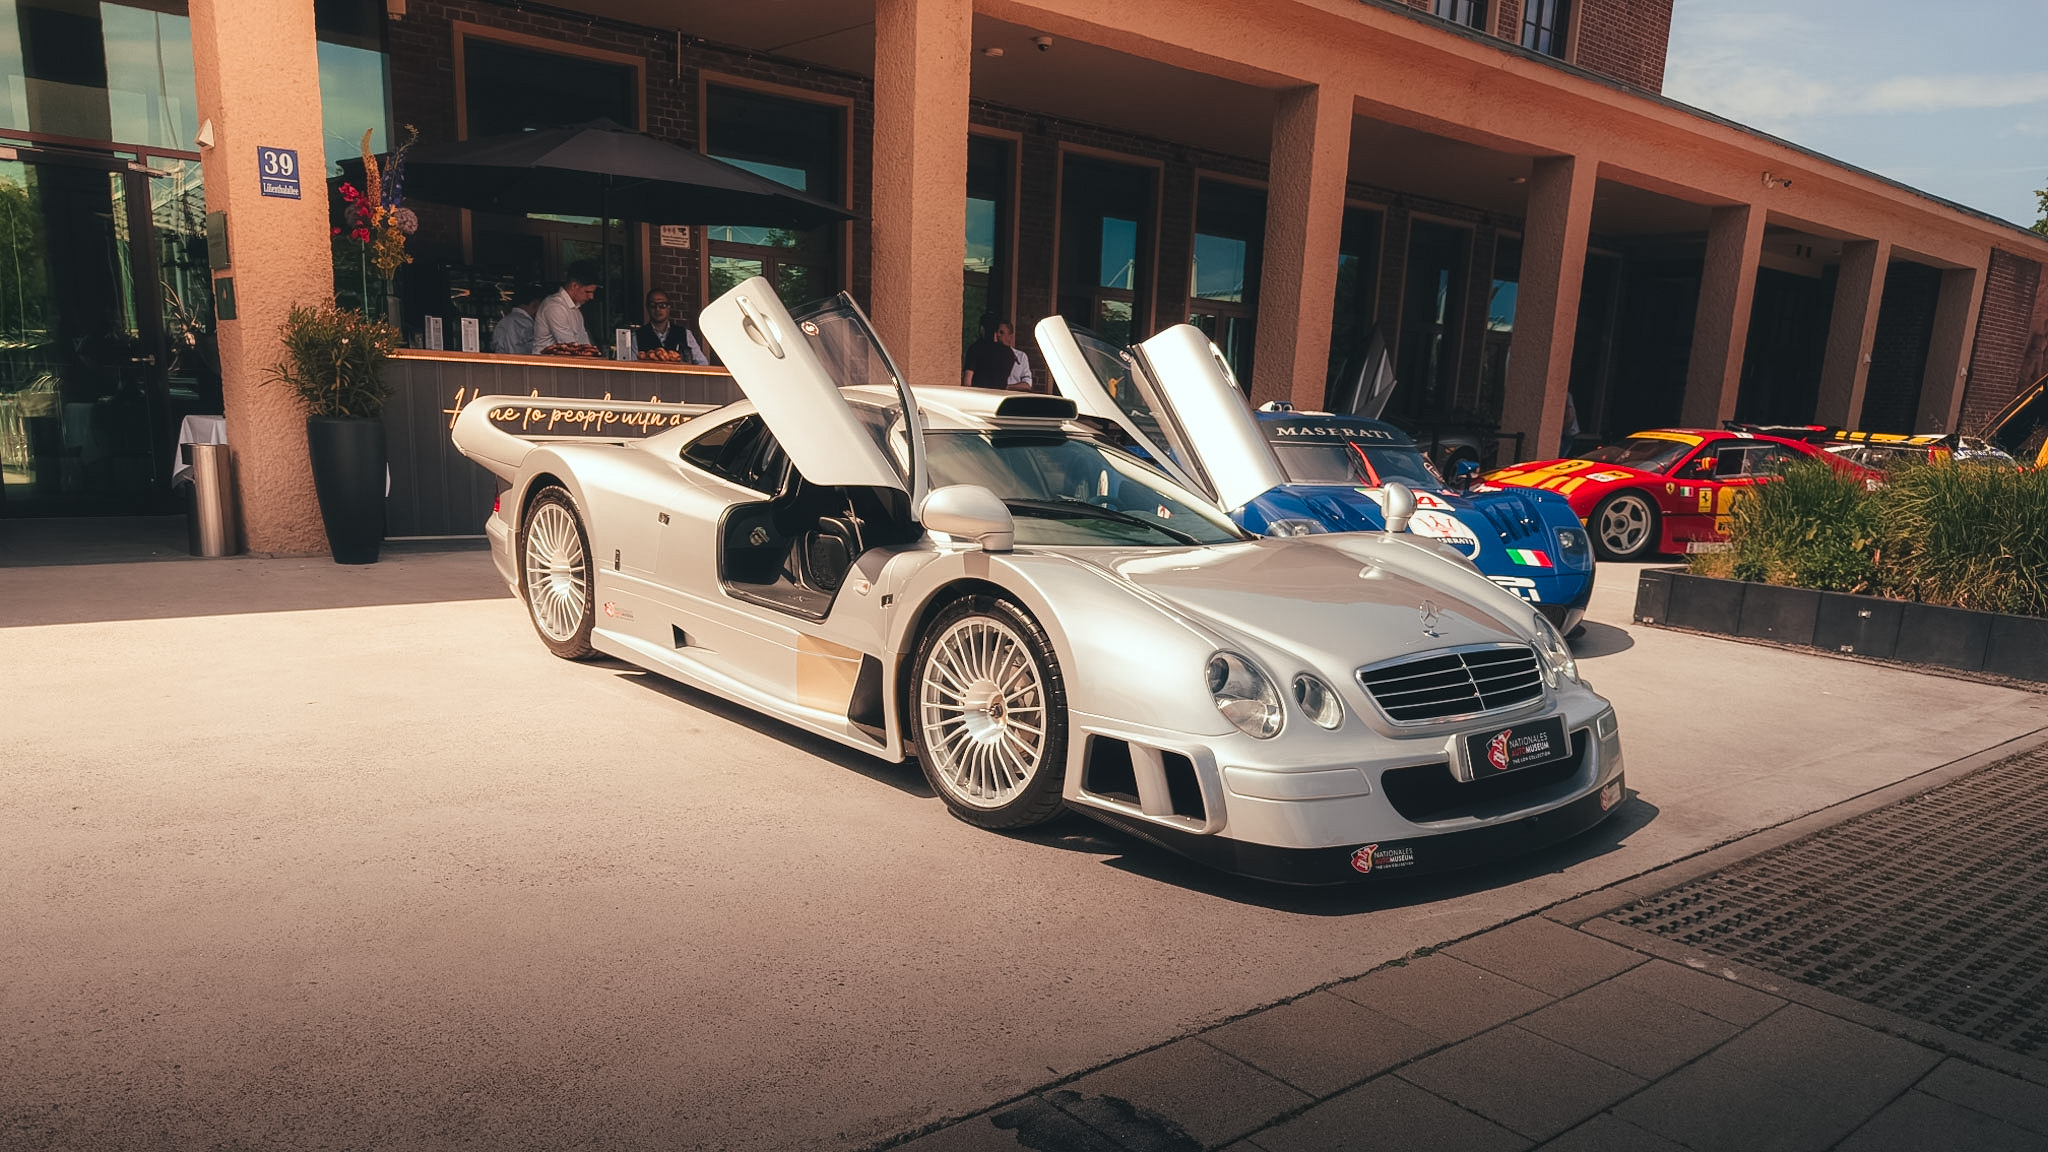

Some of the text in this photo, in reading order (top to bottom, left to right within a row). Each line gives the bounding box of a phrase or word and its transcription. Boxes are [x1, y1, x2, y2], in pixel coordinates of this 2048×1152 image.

[264, 151, 294, 176] 39
[1276, 427, 1394, 440] MASERATI
[1509, 732, 1547, 748] NATIONALES
[1511, 741, 1550, 757] AUTOMUSEUM
[1374, 848, 1413, 858] NATIONALES
[1375, 855, 1414, 865] AUTOMUSEUM
